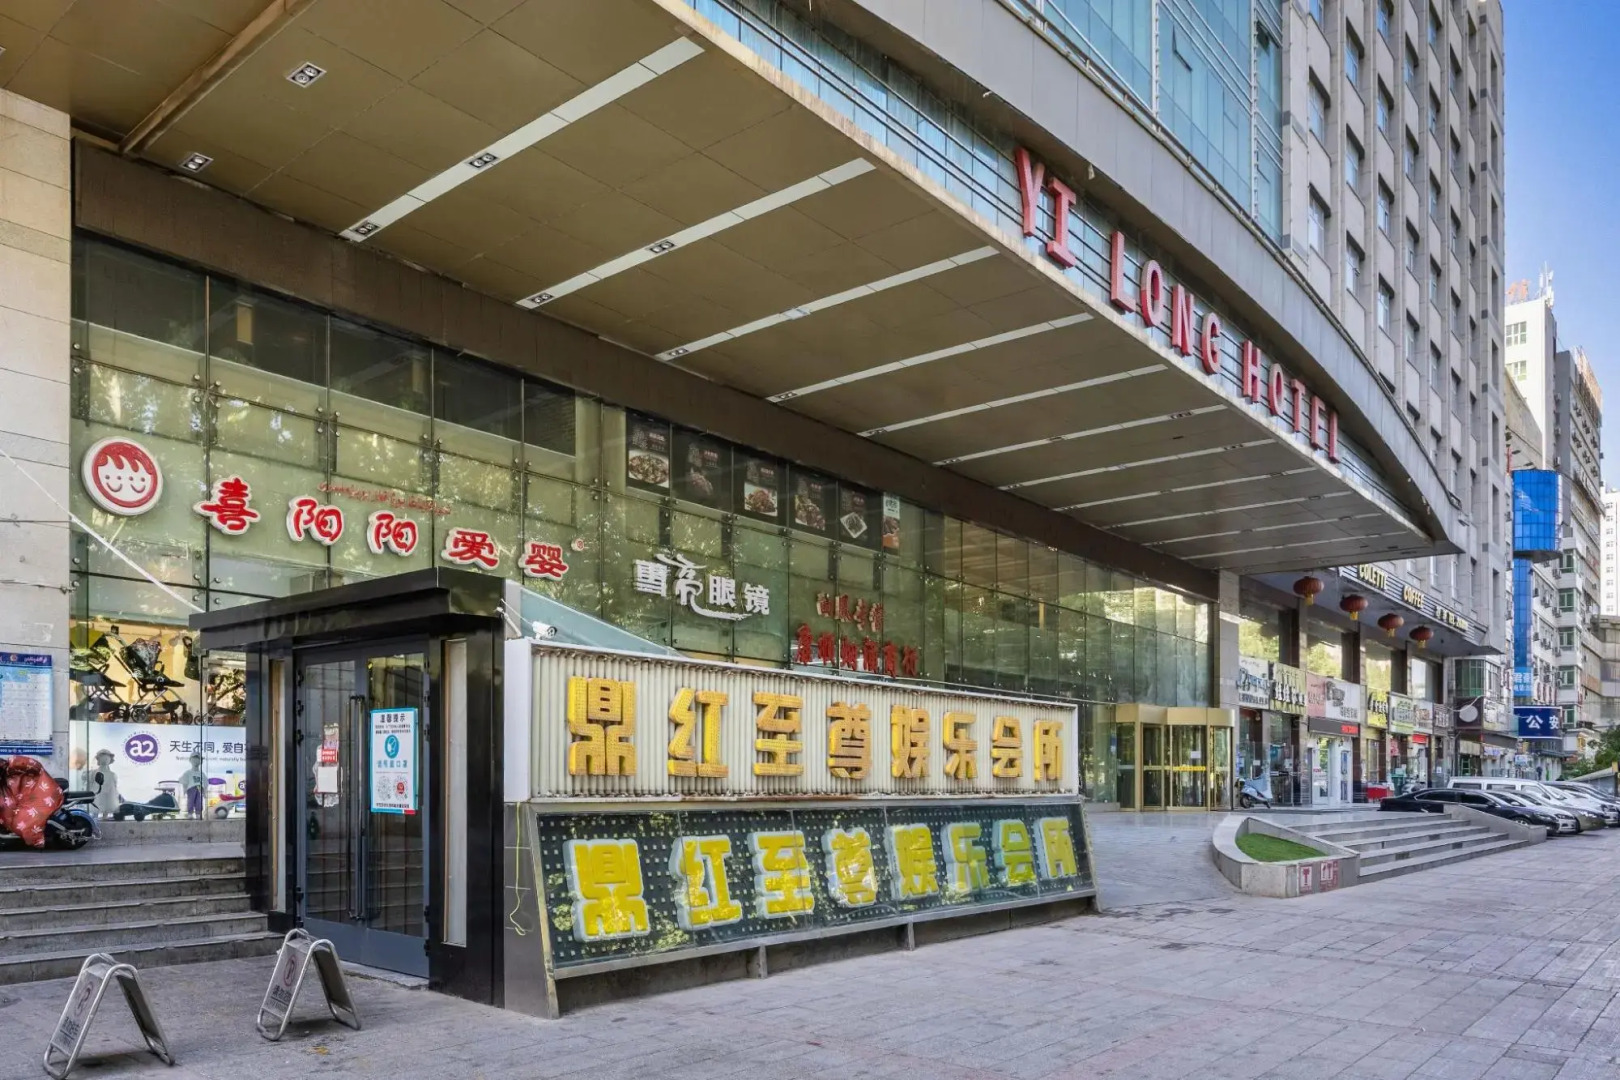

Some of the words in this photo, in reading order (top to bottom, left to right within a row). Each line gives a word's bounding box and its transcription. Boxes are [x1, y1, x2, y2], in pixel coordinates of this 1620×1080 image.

[1014, 146, 1077, 269] YI
[1110, 230, 1223, 376] LONG
[1241, 339, 1340, 464] HOTEL
[195, 475, 571, 581] 喜阳阳爱婴
[633, 552, 770, 621] 雪亮眼镜
[129, 739, 156, 758] a2
[567, 676, 1065, 782] 鼎红至尊娱乐会所
[1525, 714, 1561, 730] 公安
[563, 817, 1077, 943] 鼎红至尊娱乐会所
